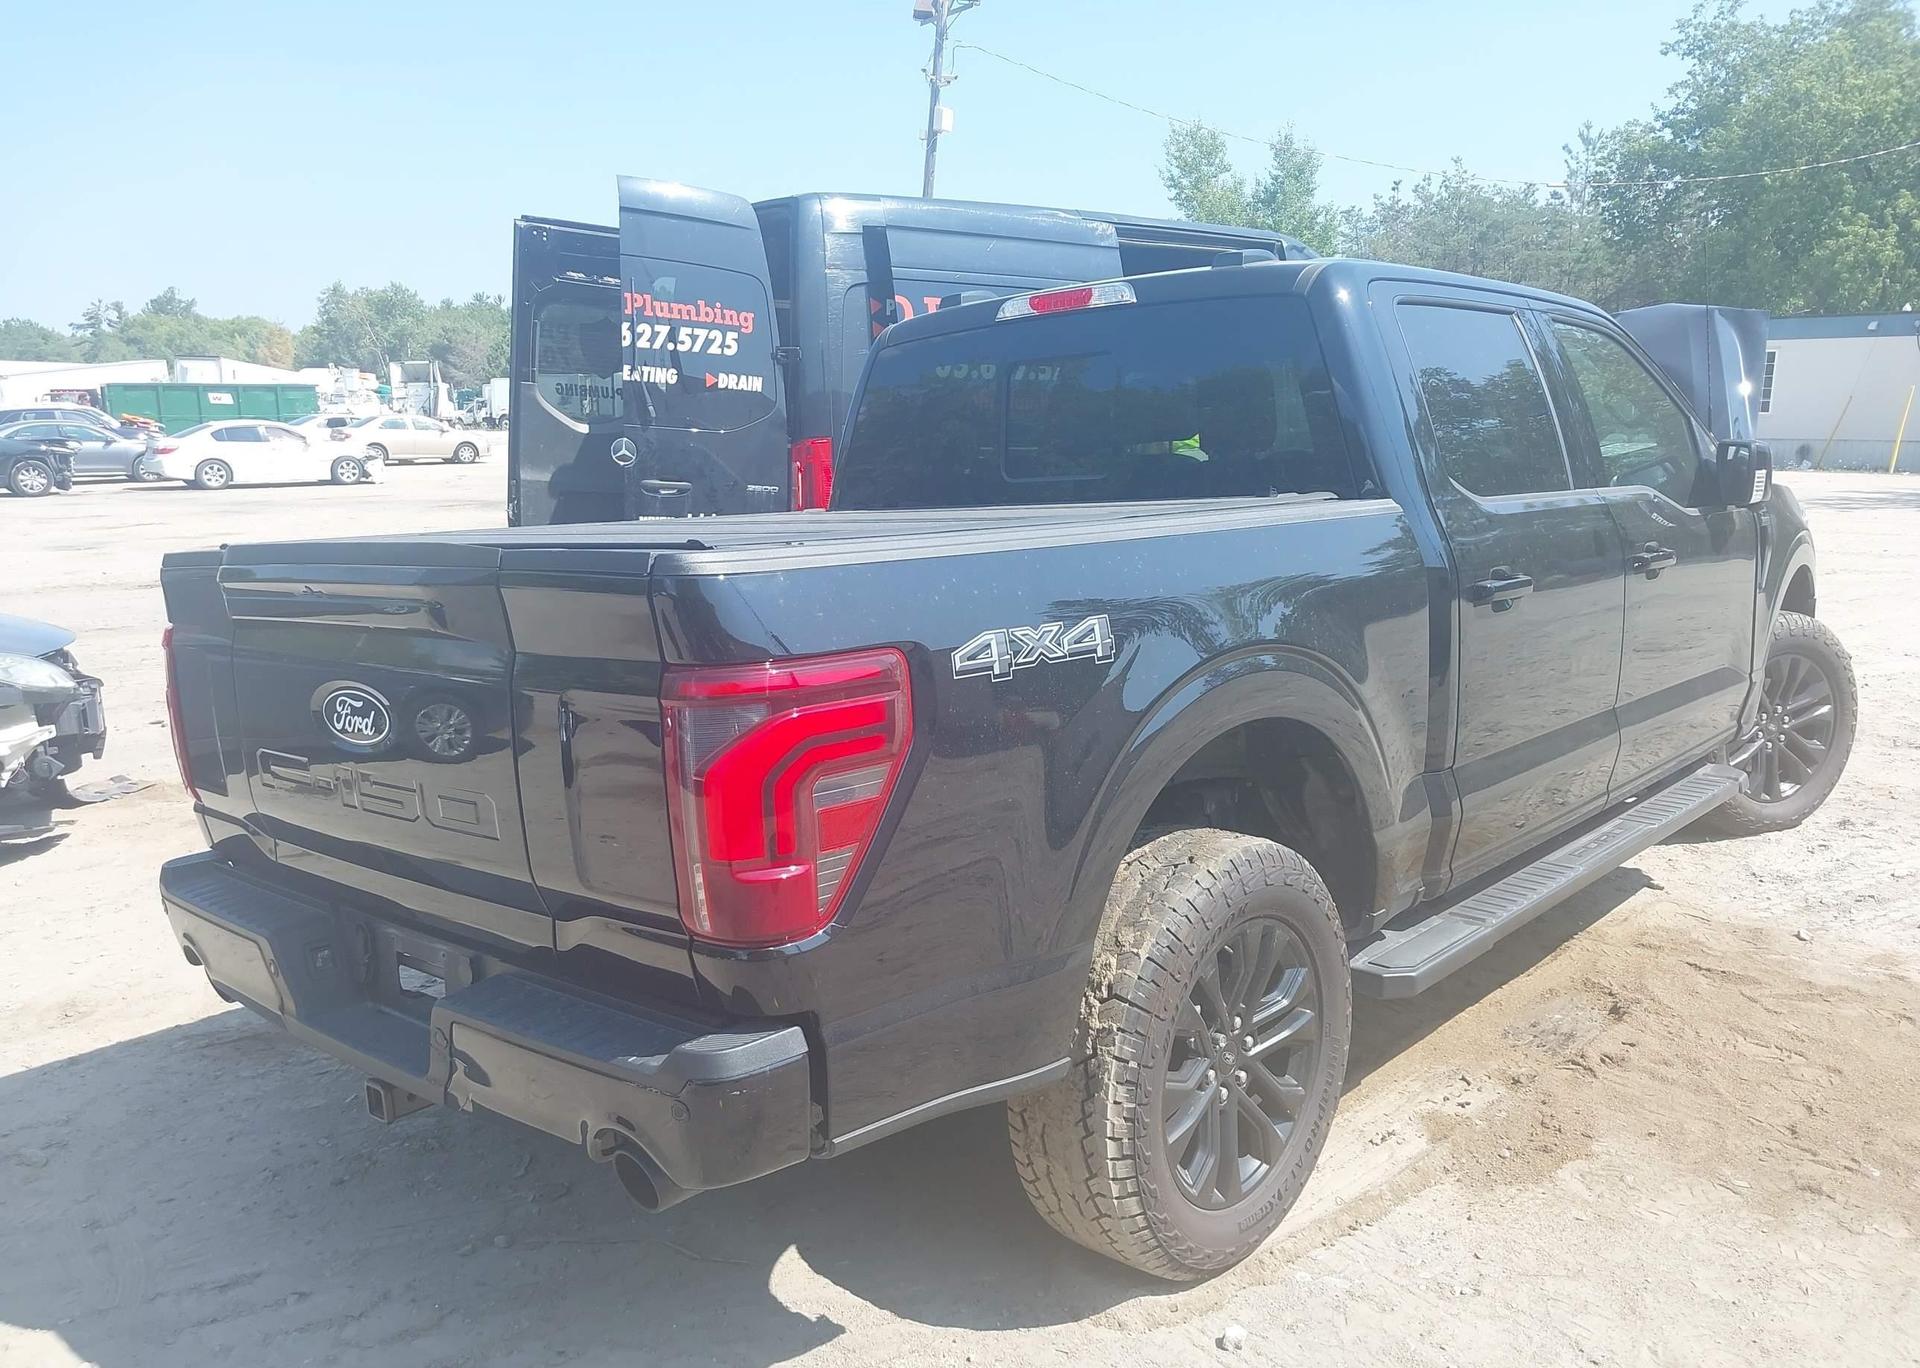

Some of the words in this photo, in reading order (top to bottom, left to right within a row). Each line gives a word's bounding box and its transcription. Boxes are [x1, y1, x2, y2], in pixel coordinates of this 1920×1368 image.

[623, 292, 755, 334] Plumbing
[717, 372, 763, 393] DRAIN
[331, 695, 380, 738] Ford
[257, 748, 500, 840] F-150
